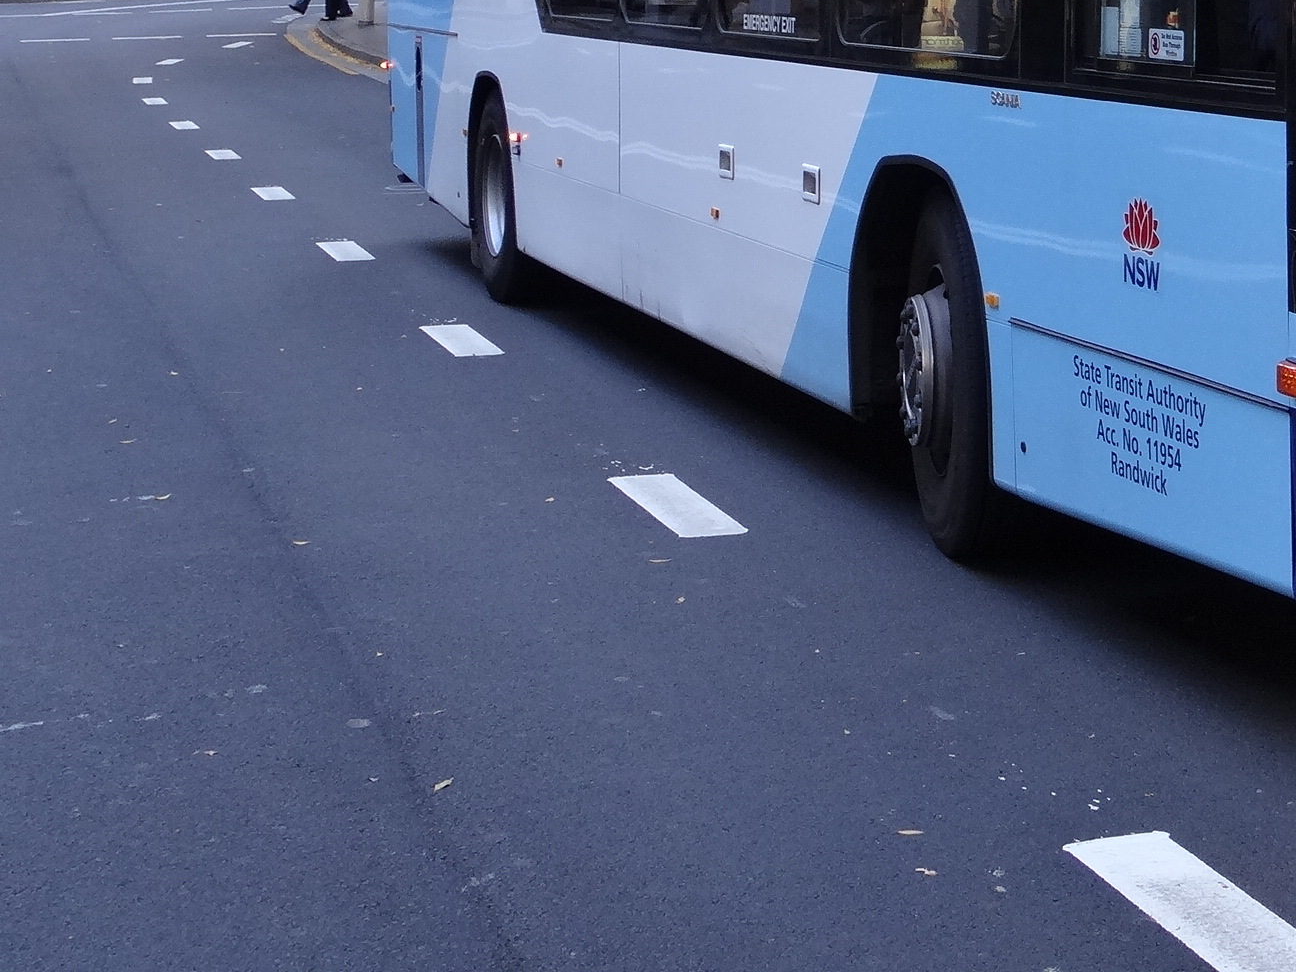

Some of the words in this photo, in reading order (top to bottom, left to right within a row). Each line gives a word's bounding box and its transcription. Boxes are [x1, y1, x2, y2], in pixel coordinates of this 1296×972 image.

[743, 13, 781, 33] EMERGENCY
[782, 16, 797, 34] EXIT
[990, 90, 1022, 110] SCANIA
[1123, 253, 1161, 291] NSW
[1073, 355, 1101, 385] State
[1104, 364, 1143, 400] Transit
[1146, 379, 1206, 427] Authority
[1080, 385, 1092, 408] of
[1095, 389, 1121, 419] New
[1124, 400, 1158, 434] South
[1161, 412, 1200, 449] Wales
[1096, 418, 1119, 447] Acc.
[1122, 427, 1142, 457] No.
[1146, 437, 1182, 472] 11954
[1110, 450, 1168, 496] Randwick
